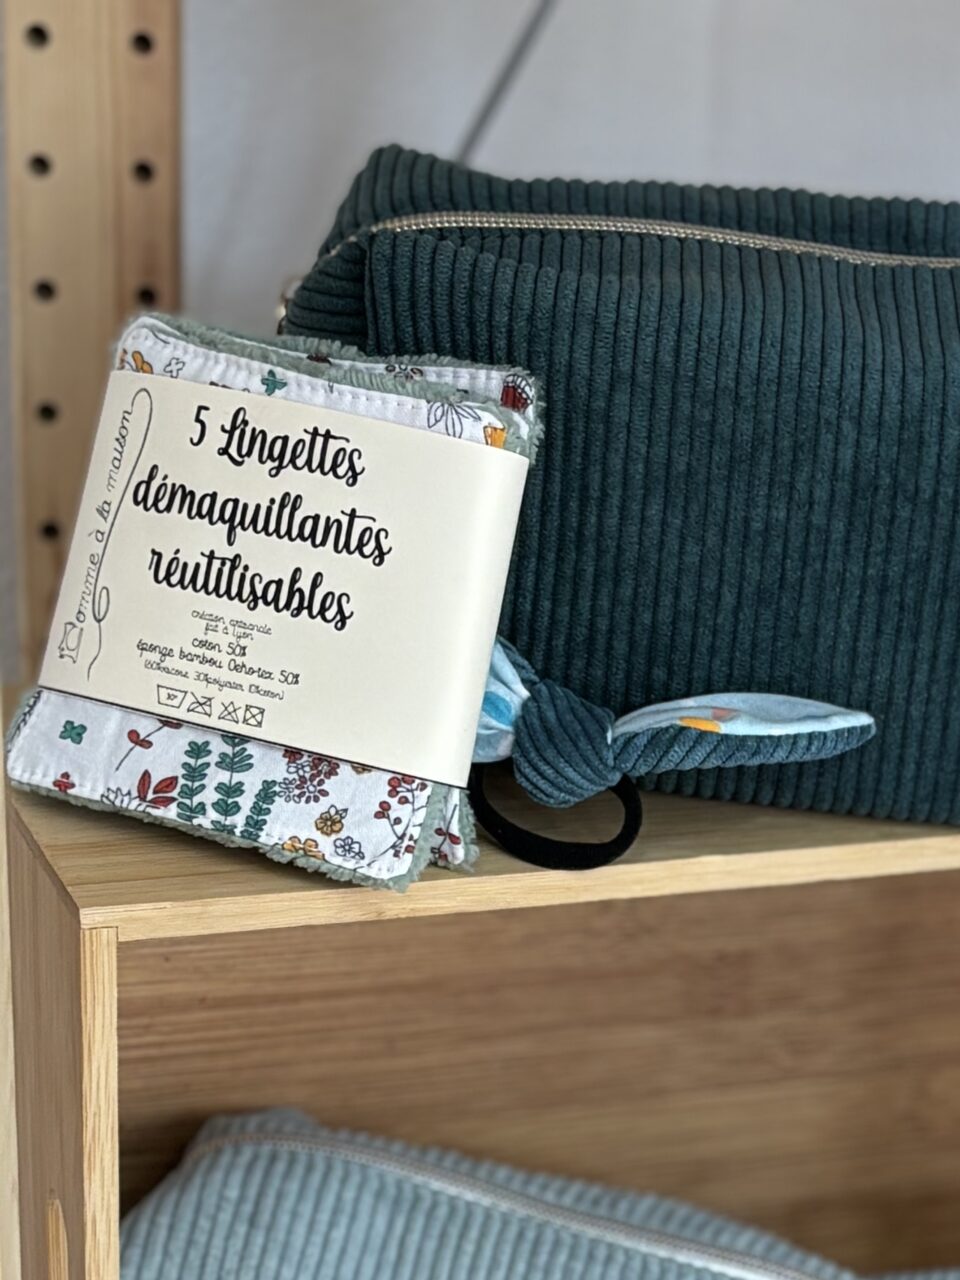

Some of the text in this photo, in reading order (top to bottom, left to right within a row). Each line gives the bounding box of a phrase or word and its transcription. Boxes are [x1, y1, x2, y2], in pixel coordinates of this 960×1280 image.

[107, 409, 134, 492] maison
[189, 404, 365, 487] 5 Lingettes
[87, 529, 106, 543] à
[96, 500, 112, 523] la
[132, 464, 392, 567] démaquillantes
[148, 548, 354, 631] réutilisables
